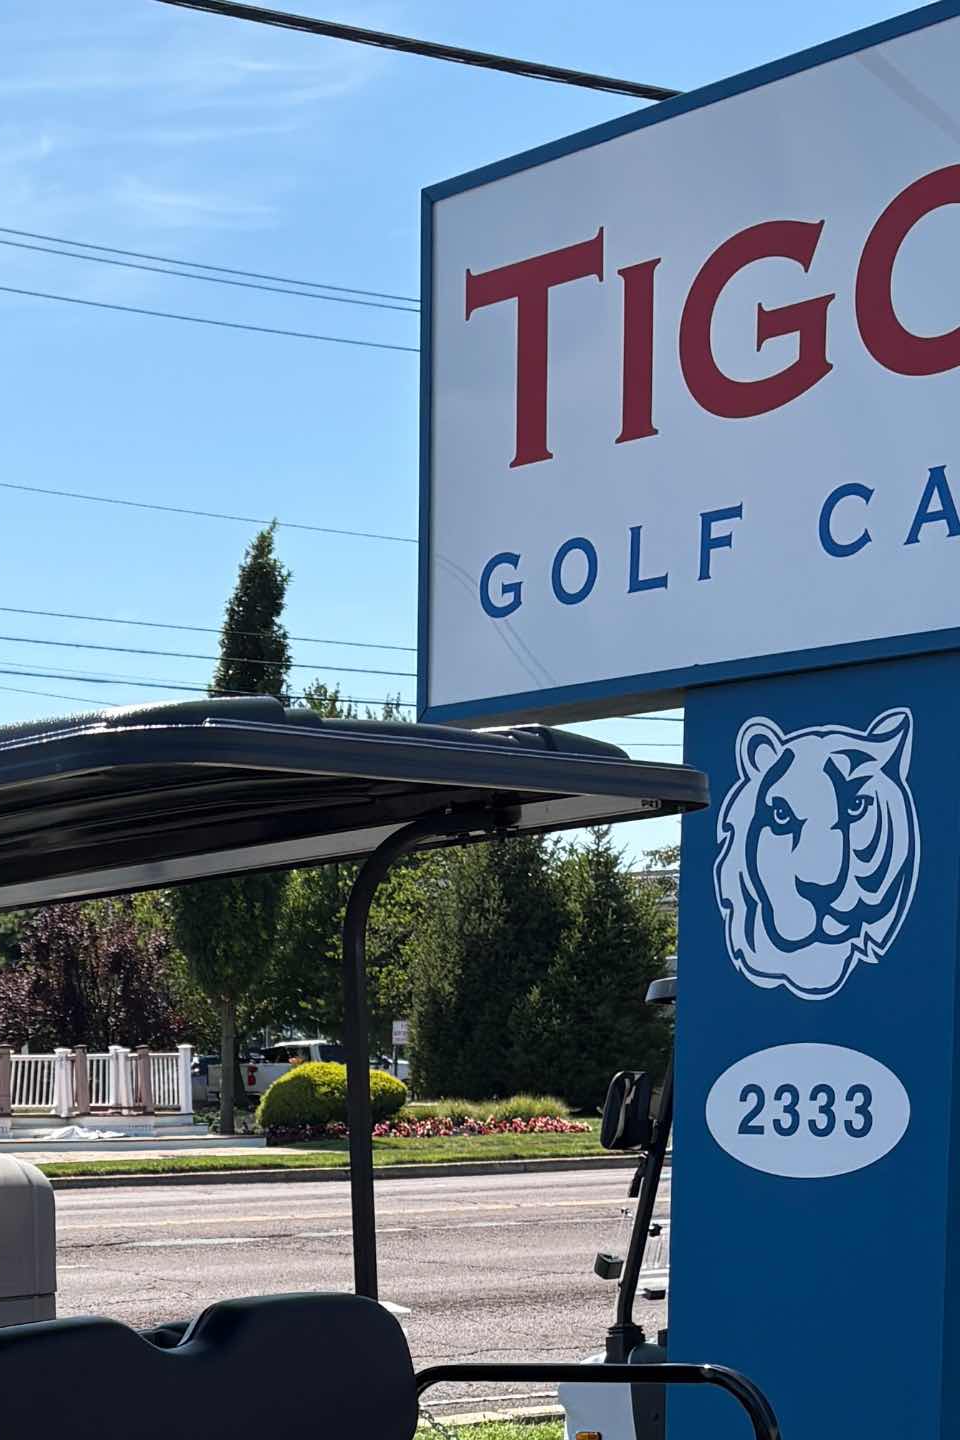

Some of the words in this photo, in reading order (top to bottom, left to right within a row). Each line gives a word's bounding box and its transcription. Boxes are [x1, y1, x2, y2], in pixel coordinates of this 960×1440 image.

[479, 502, 743, 619] GOLF
[817, 464, 960, 559] CA
[738, 1084, 873, 1139] 2333
